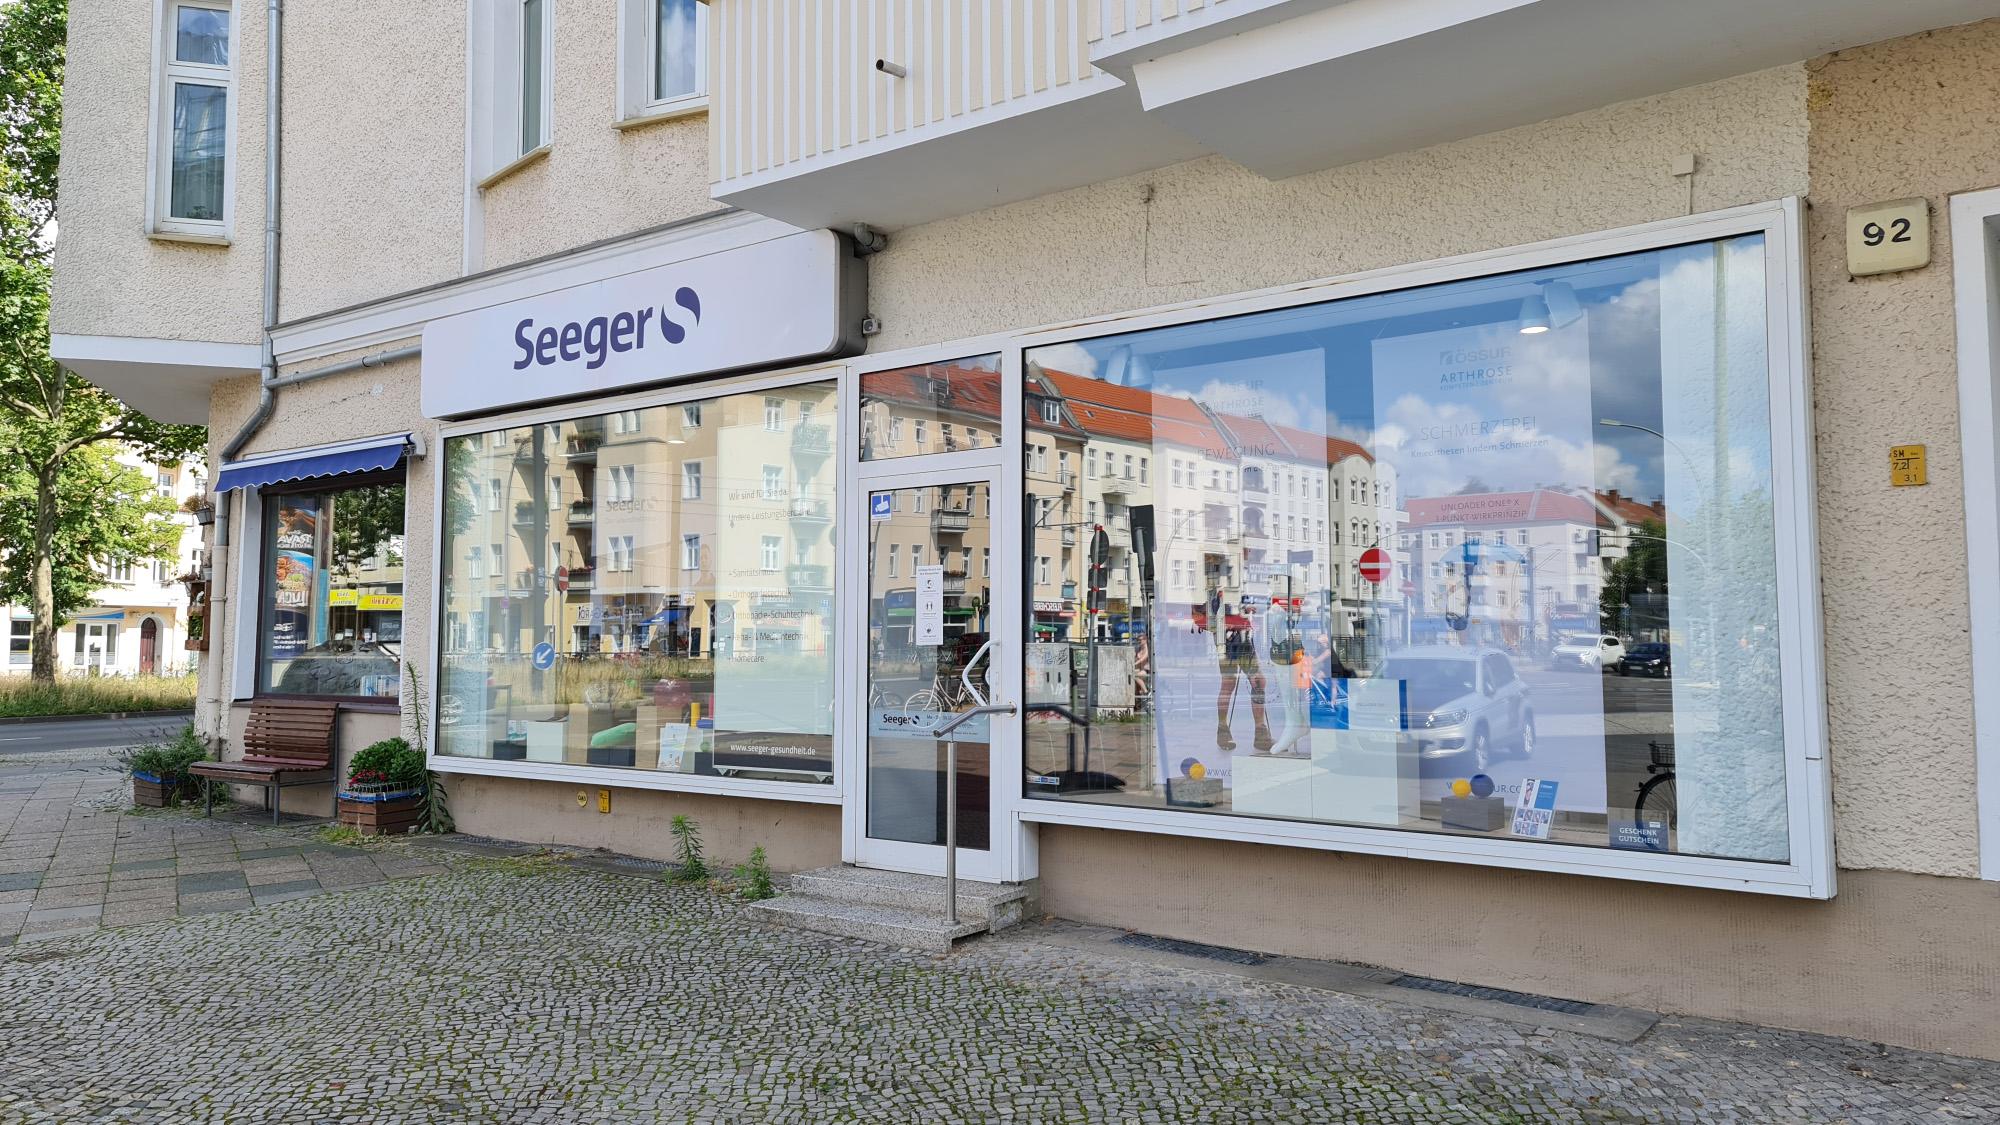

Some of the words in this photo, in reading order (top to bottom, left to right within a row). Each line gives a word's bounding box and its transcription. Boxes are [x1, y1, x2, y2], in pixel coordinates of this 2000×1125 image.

[1863, 217, 1911, 247] 92
[513, 306, 654, 370] Seeger
[1440, 366, 1513, 384] ARTHROSE
[883, 713, 912, 726] Seeger
[730, 743, 816, 756] www.seeger-gesundheit.de
[1619, 827, 1658, 837] GESCHENK
[1618, 835, 1660, 845] GUTSCHEIN
